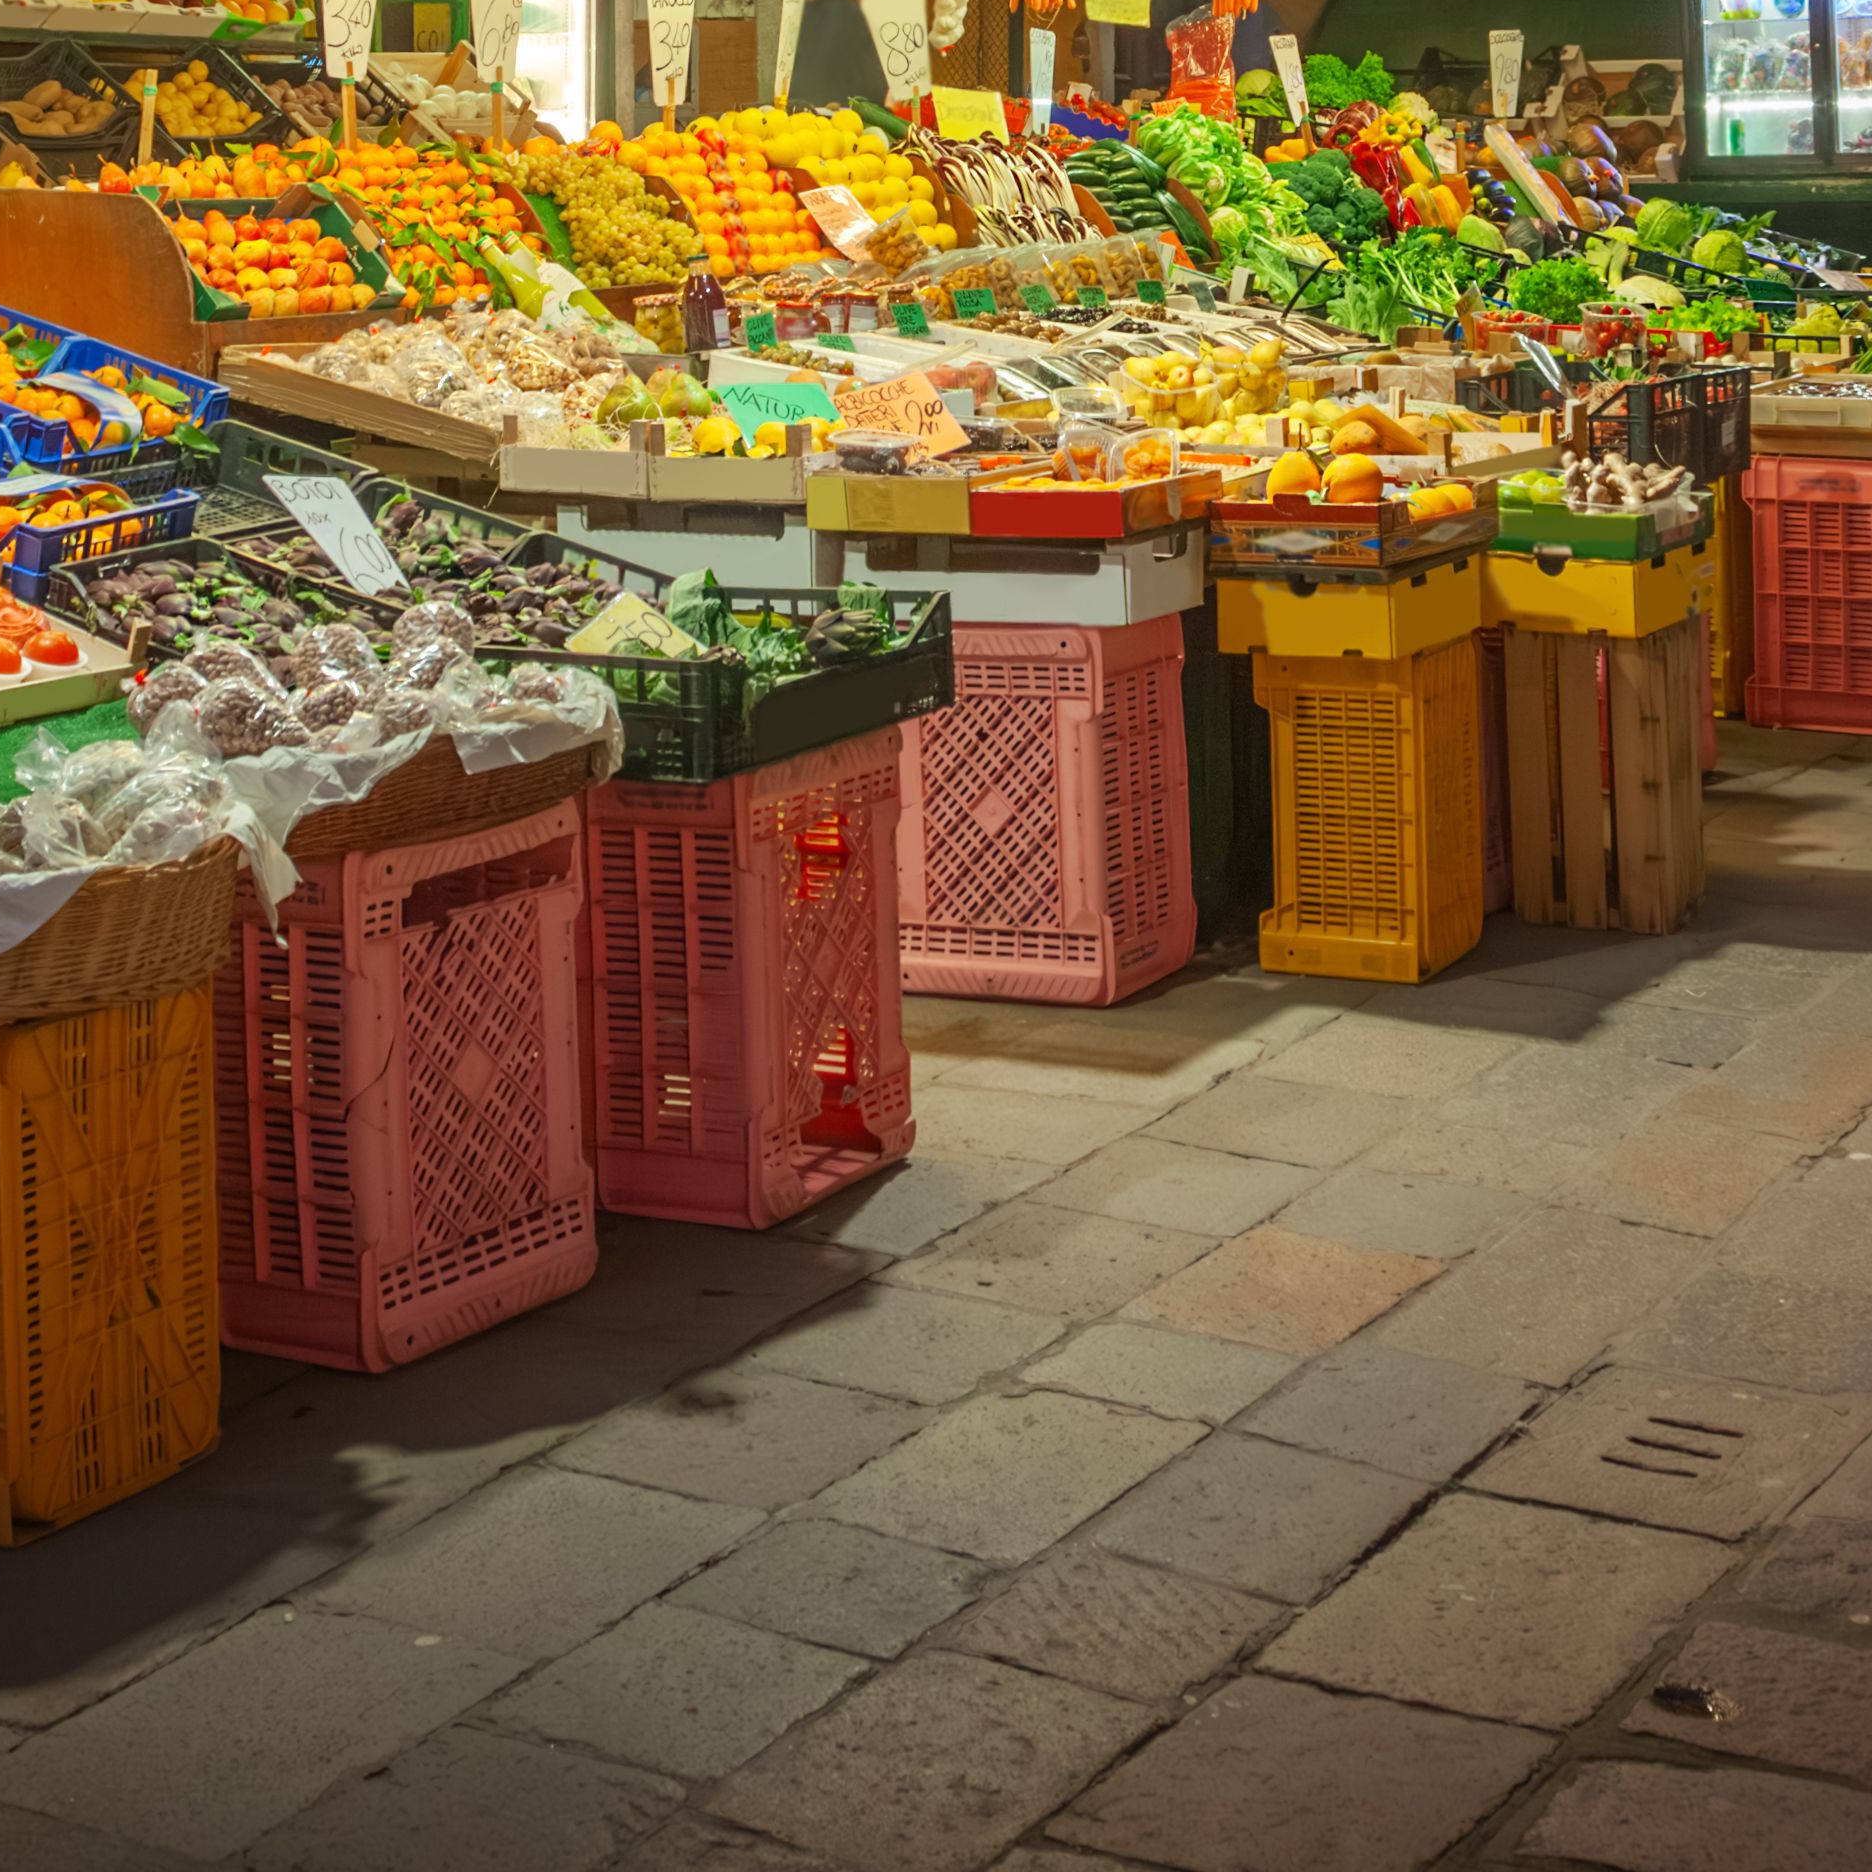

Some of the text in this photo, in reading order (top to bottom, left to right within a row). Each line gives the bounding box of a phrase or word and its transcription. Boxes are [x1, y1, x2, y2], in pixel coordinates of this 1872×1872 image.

[653, 20, 690, 71] 340
[880, 21, 924, 77] 880
[833, 379, 915, 412] ALBICOCCHE
[844, 403, 898, 428] DATTERI
